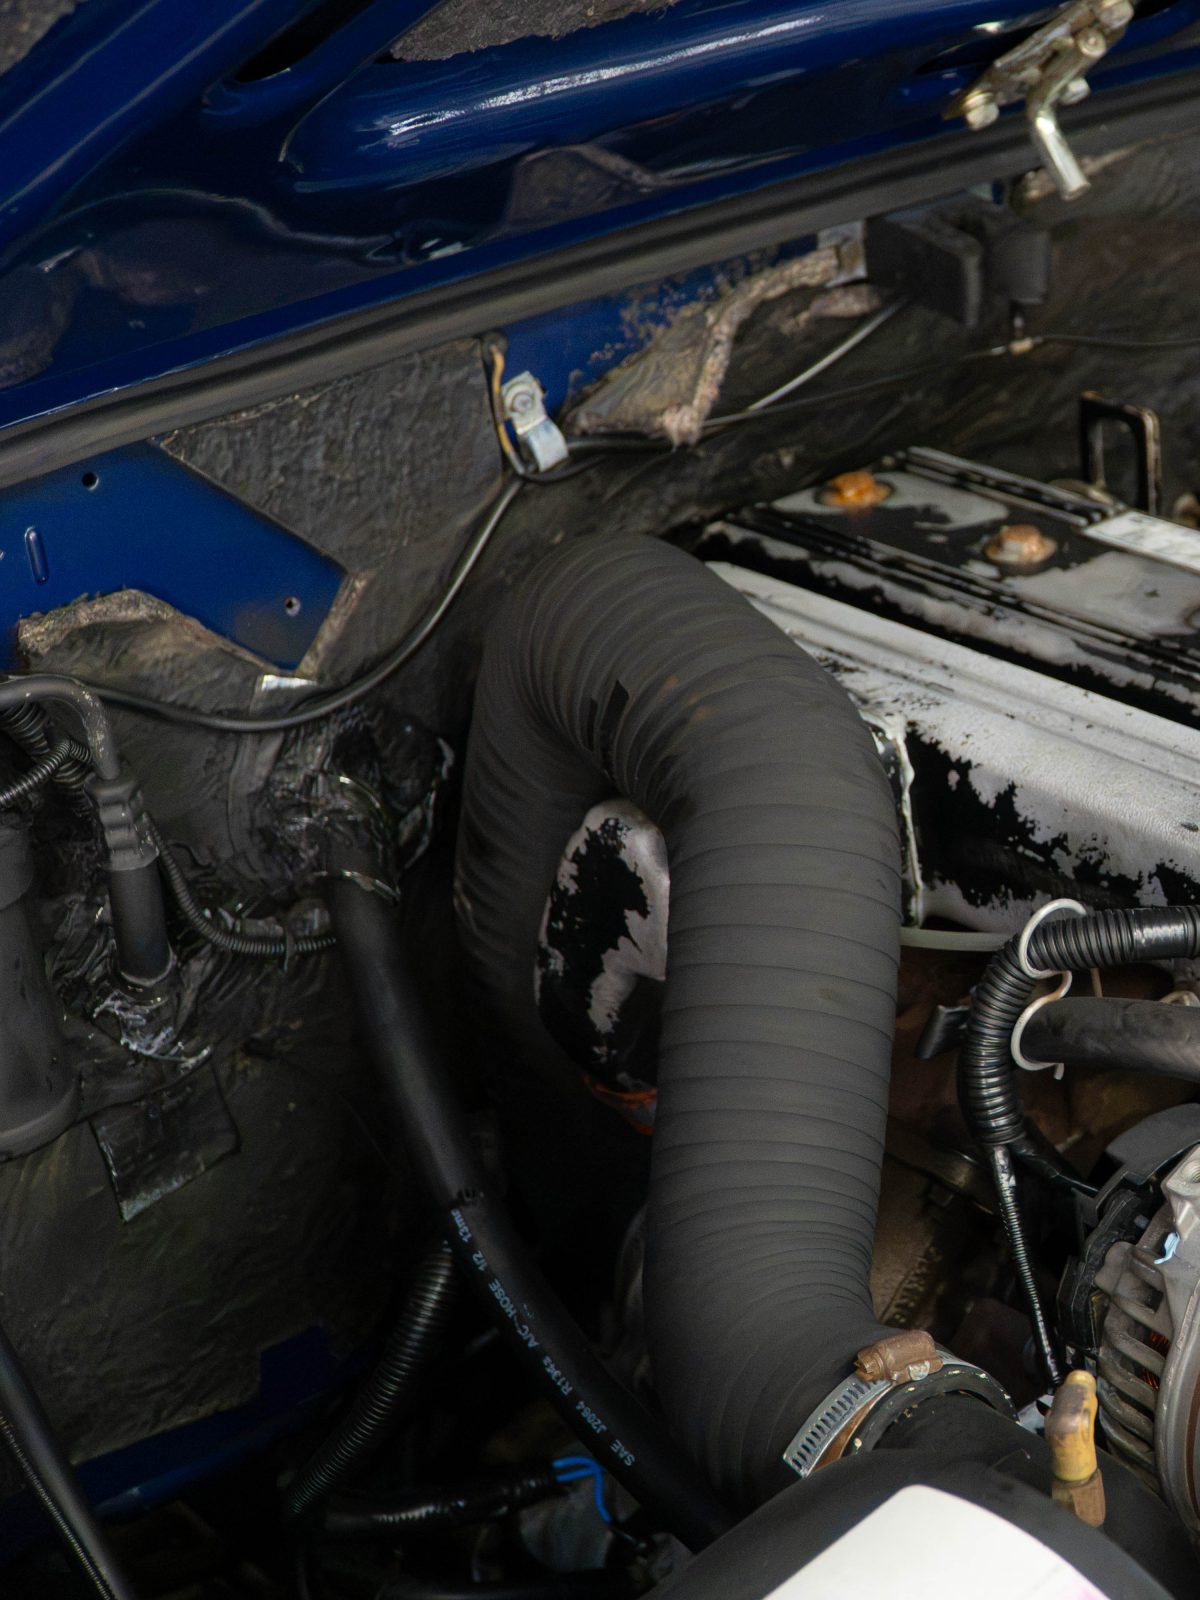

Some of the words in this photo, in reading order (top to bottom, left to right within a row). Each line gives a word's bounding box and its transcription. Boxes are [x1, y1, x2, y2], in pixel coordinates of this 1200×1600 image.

[472, 1250, 487, 1271] 1/2
[488, 1279, 517, 1318] HOSE
[517, 1325, 539, 1348] A/C
[610, 1439, 635, 1466] SAE
